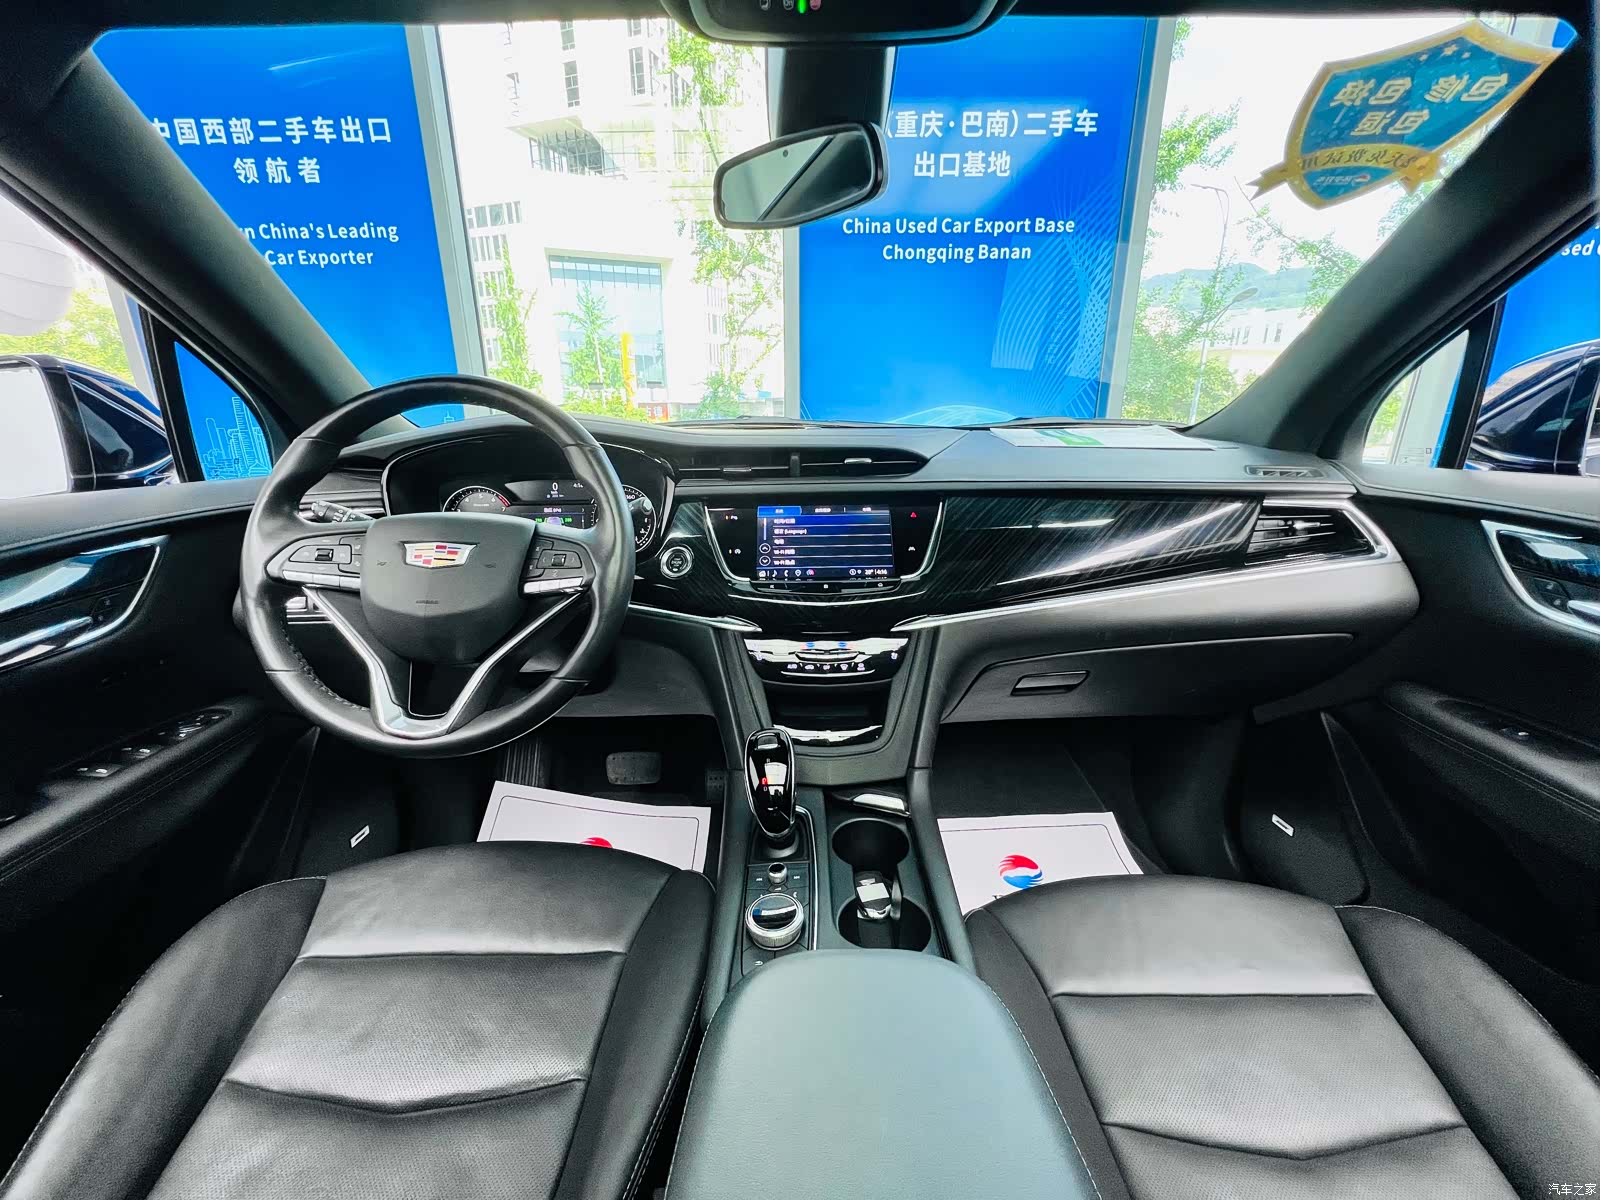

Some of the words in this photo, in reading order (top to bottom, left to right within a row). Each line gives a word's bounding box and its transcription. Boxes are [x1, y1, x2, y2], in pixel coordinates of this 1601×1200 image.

[151, 115, 392, 146] 中国西部二手车出口
[233, 156, 321, 184] 领航者
[913, 150, 1011, 178] 出口基地
[258, 222, 325, 240] China's
[327, 222, 399, 242] Leading
[842, 217, 891, 234] China
[895, 217, 938, 234] Used
[941, 217, 971, 234] Car
[974, 217, 1031, 237] Export
[1034, 217, 1076, 233] Base
[264, 249, 295, 266] Car
[297, 249, 374, 268] Exporter
[882, 243, 975, 264] Chongqing
[978, 244, 1032, 260] Banan
